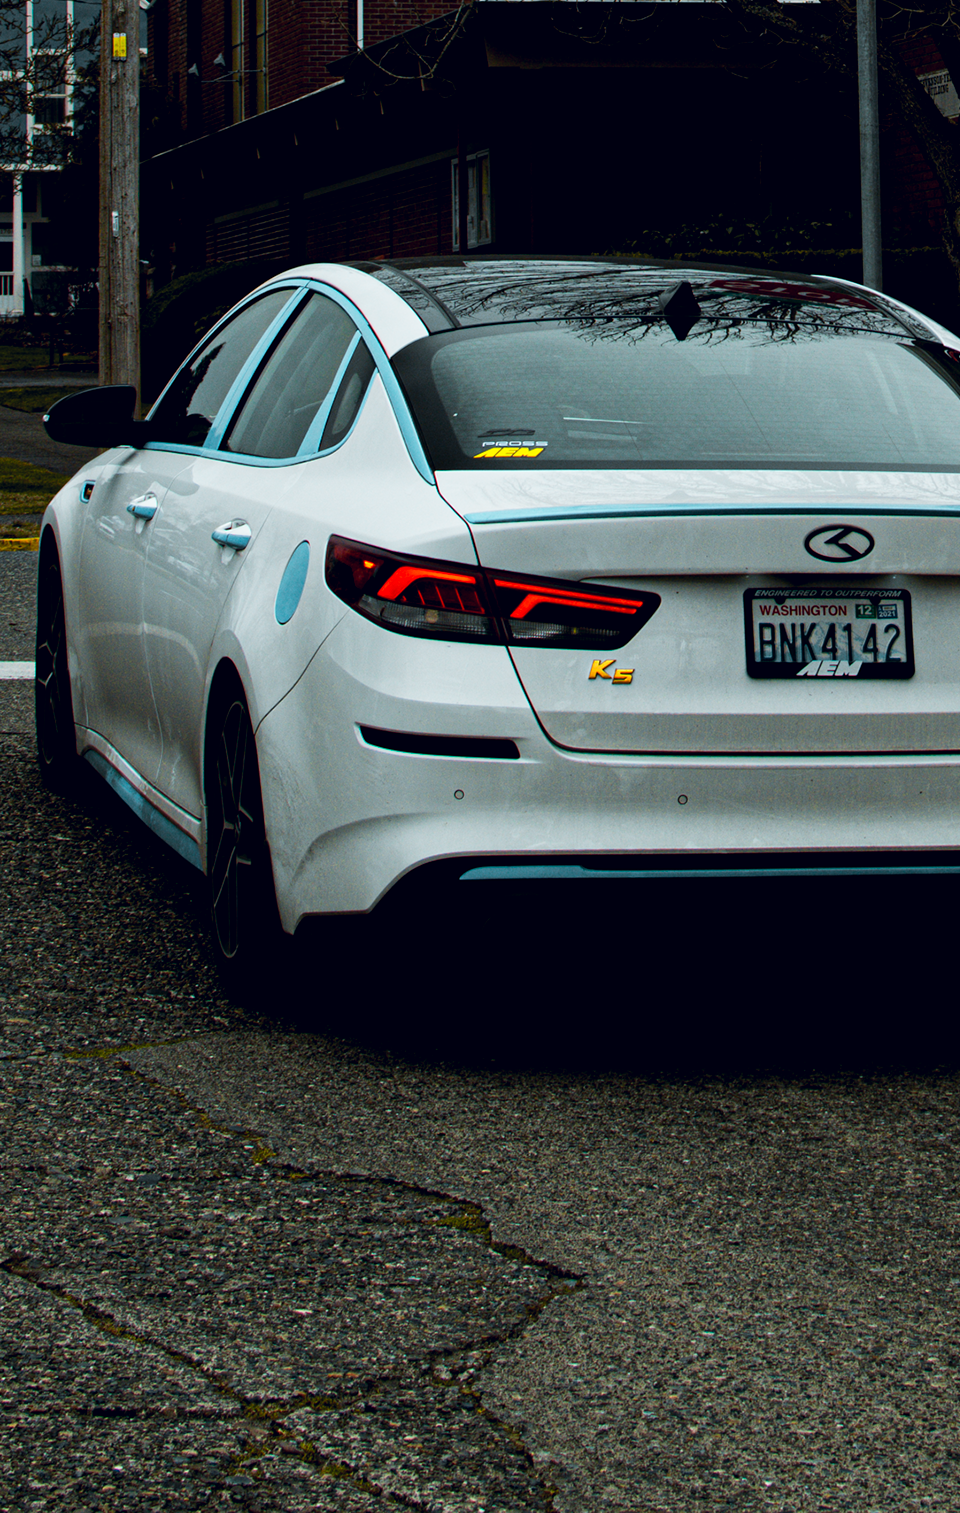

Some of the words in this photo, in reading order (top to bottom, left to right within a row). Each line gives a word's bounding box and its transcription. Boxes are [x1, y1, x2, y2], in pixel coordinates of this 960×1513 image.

[473, 447, 545, 459] AEM
[754, 589, 817, 597] ENGINEERED
[820, 589, 833, 597] TO
[835, 589, 902, 598] OUTPERFORM
[759, 604, 847, 616] WASHINGTON
[857, 605, 873, 615] 12
[758, 622, 902, 663] BNK4142
[588, 659, 636, 684] K5
[796, 660, 863, 676] AEM
